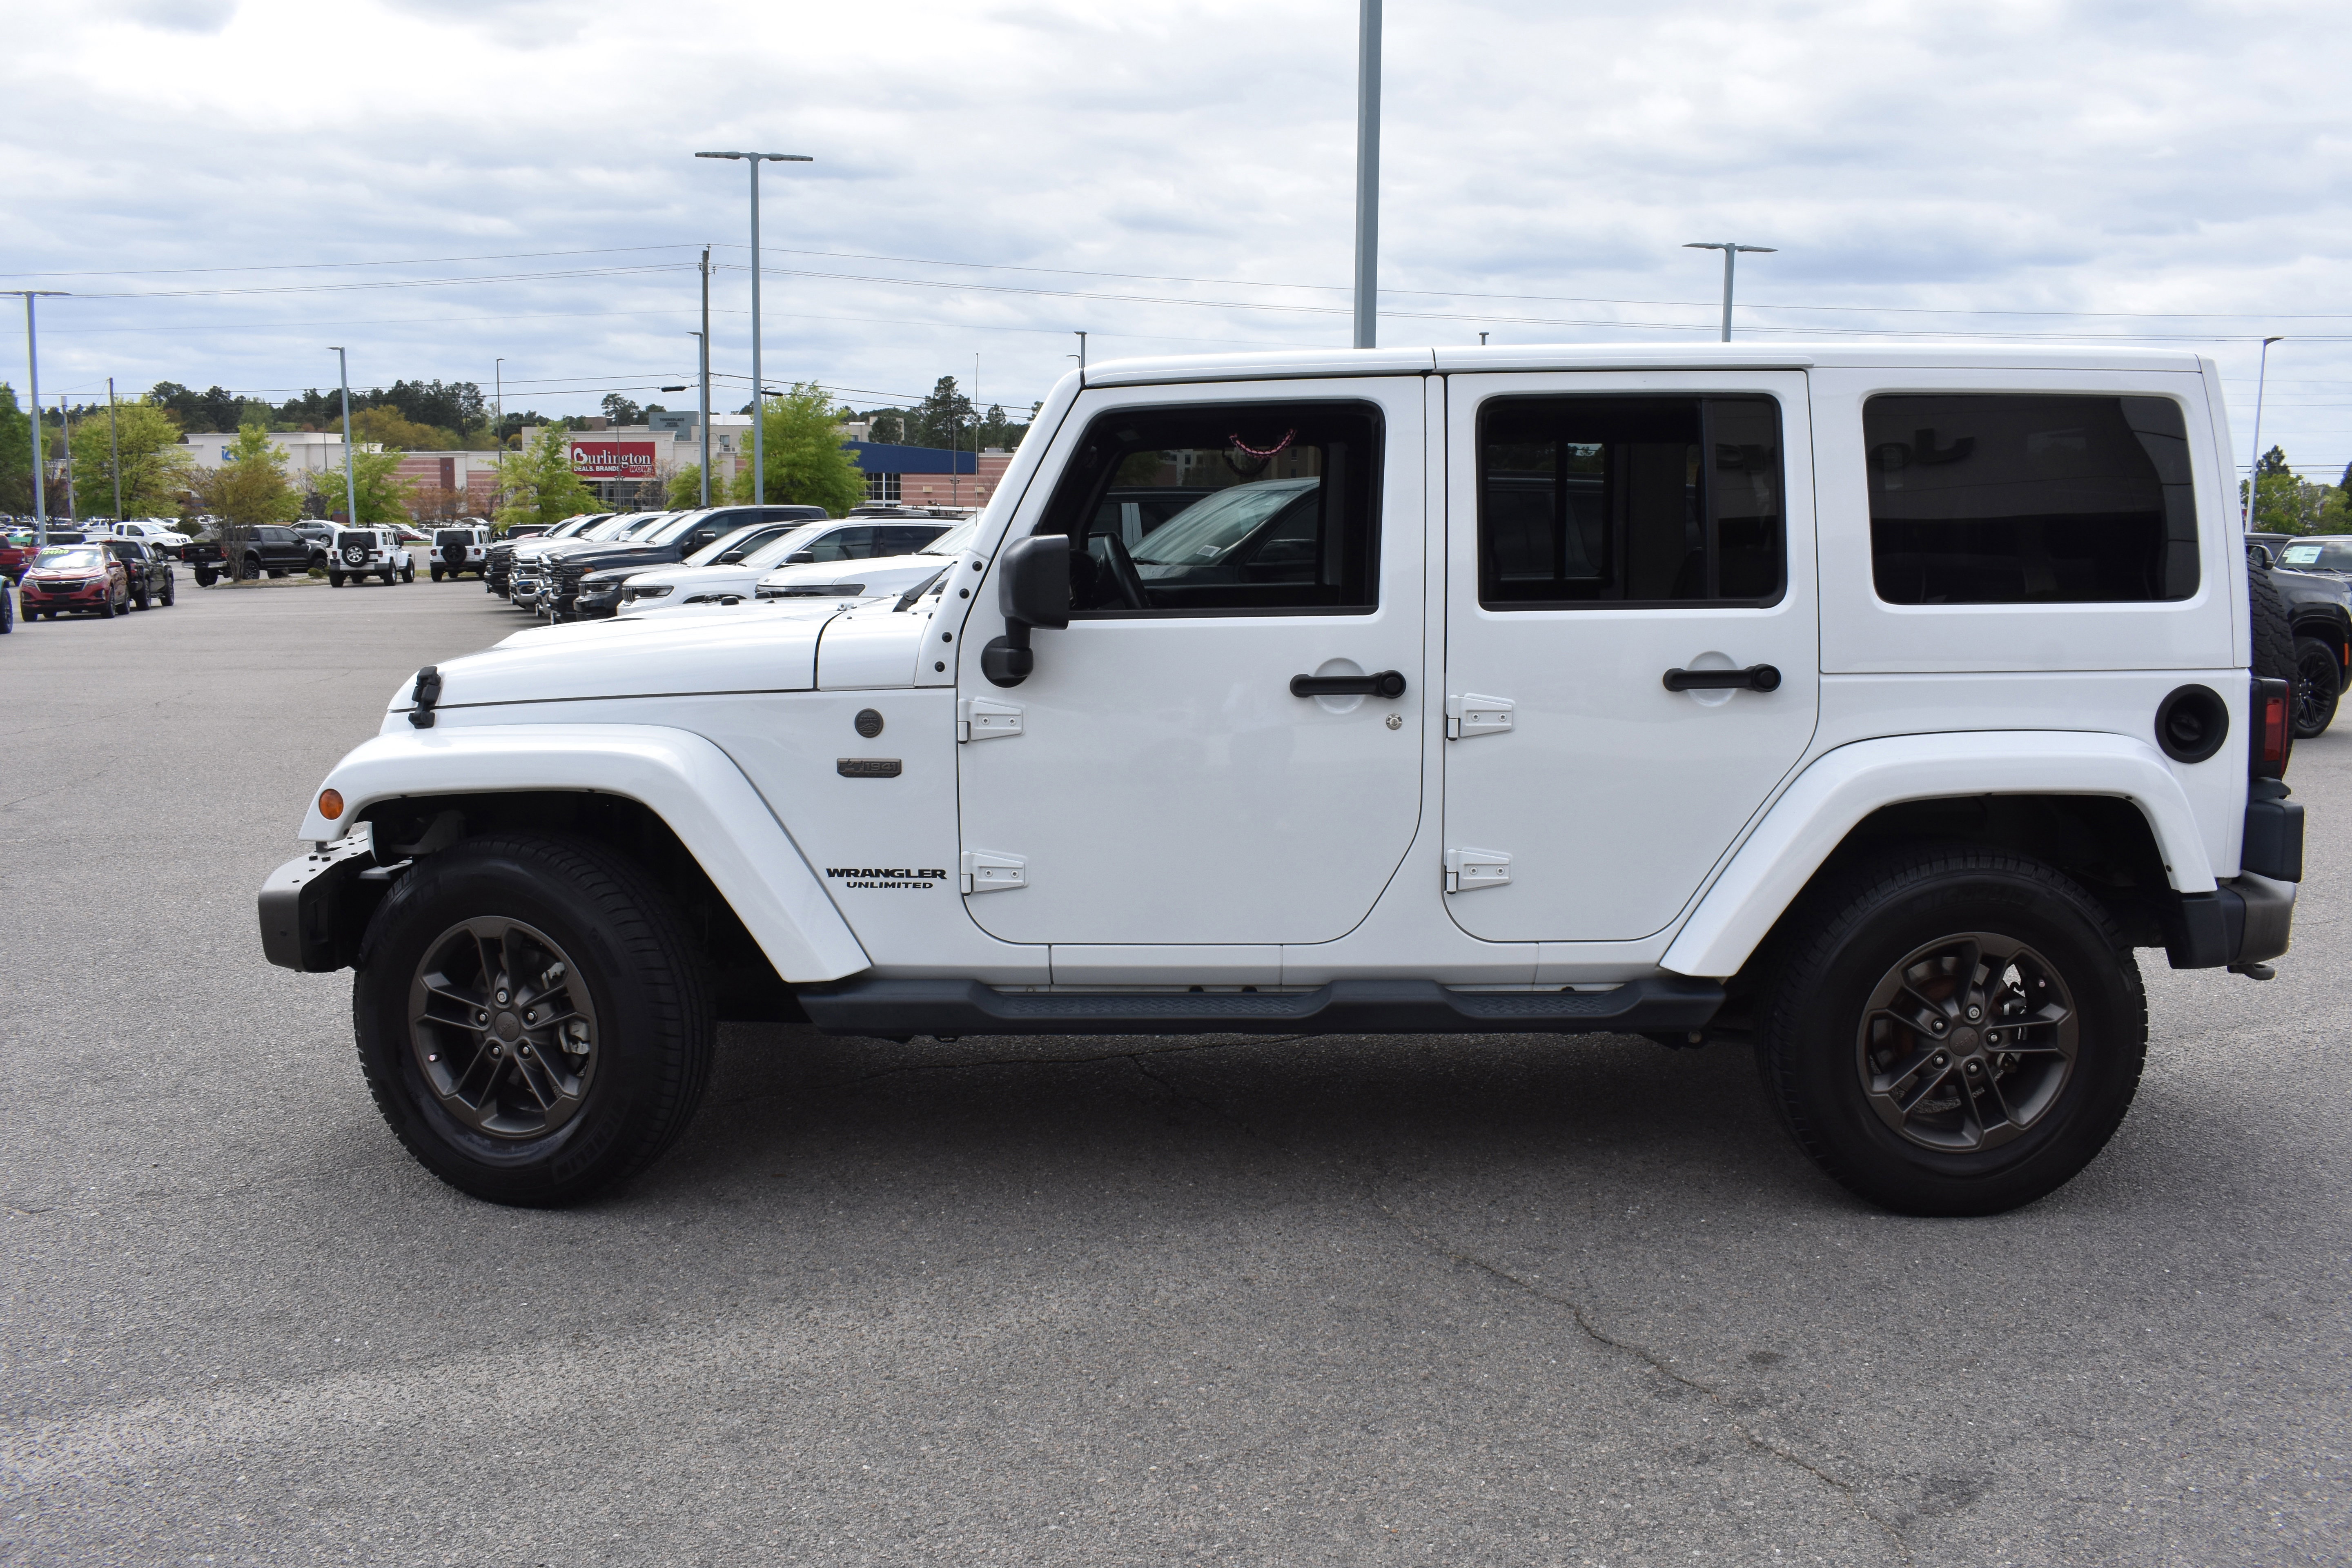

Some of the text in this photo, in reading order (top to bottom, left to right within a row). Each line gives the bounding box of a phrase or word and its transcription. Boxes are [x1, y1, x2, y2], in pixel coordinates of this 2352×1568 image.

[574, 448, 651, 468] Burlington
[865, 762, 896, 771] 1941
[826, 868, 947, 880] WRANGLER
[499, 1018, 515, 1036] Jeep
